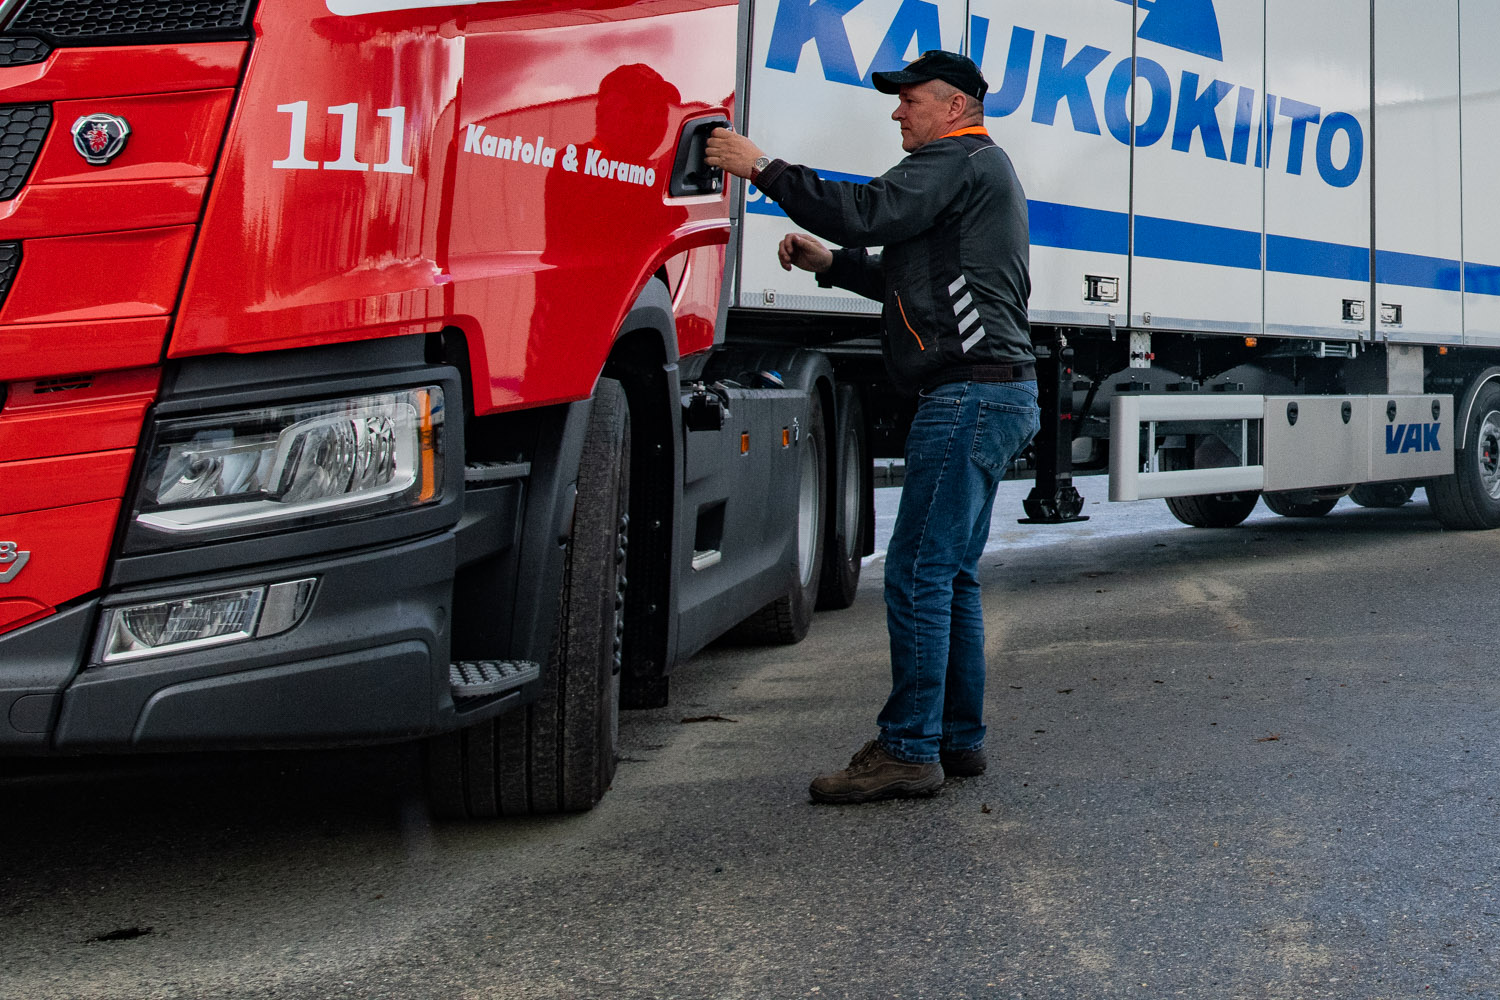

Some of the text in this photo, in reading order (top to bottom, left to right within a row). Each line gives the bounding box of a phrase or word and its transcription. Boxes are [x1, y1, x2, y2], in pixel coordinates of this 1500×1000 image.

[272, 101, 413, 175] 111
[464, 124, 656, 187] Kantola & Koramo
[1385, 423, 1441, 454] VAK
